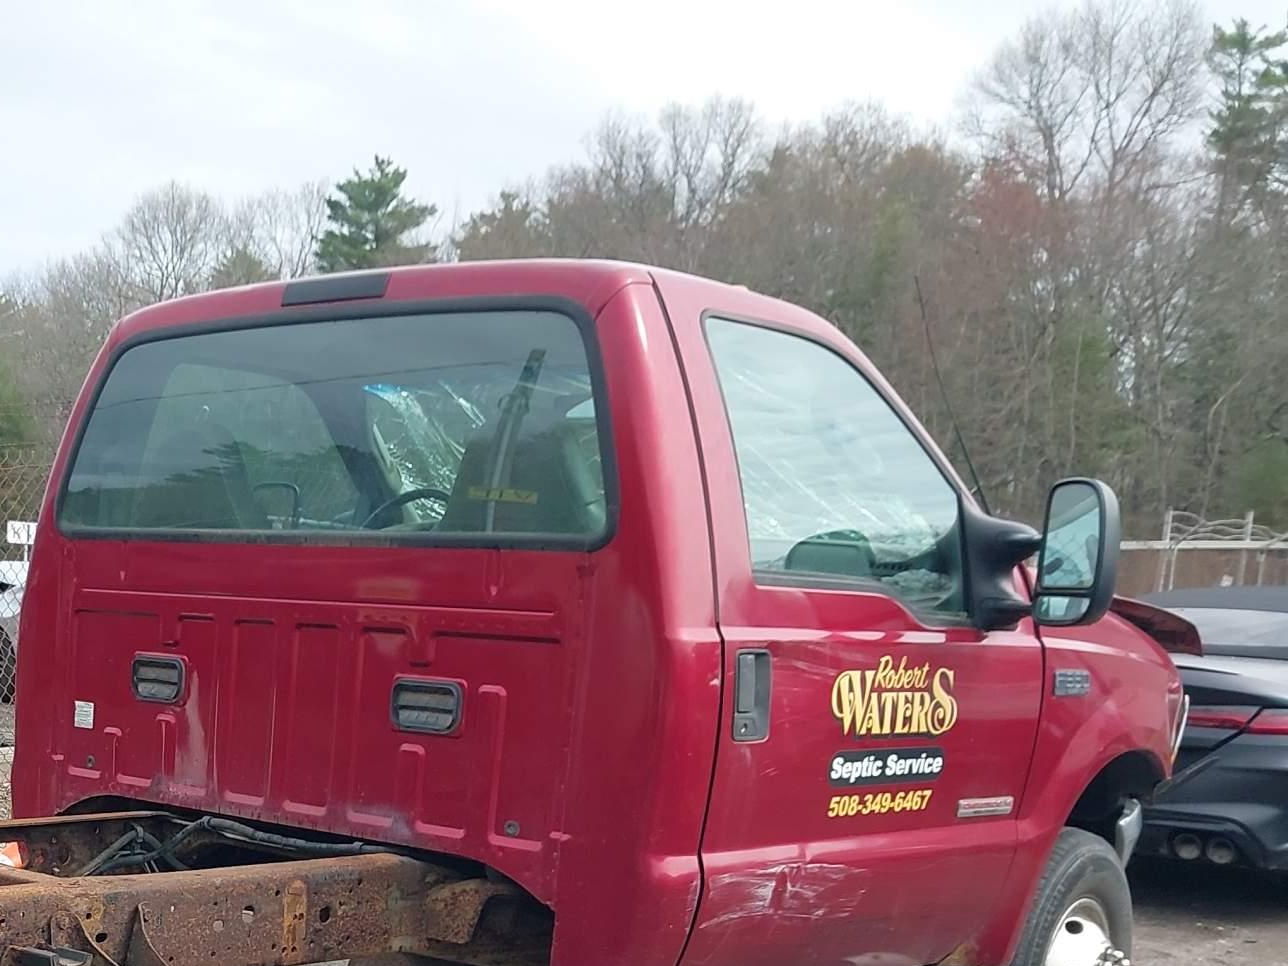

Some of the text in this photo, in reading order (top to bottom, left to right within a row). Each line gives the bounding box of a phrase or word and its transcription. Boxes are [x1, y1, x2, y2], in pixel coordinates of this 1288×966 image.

[873, 655, 931, 690] Robert
[832, 667, 958, 736] WATERS
[830, 752, 943, 783] Septic Service
[827, 789, 932, 818] 508-349-6467
